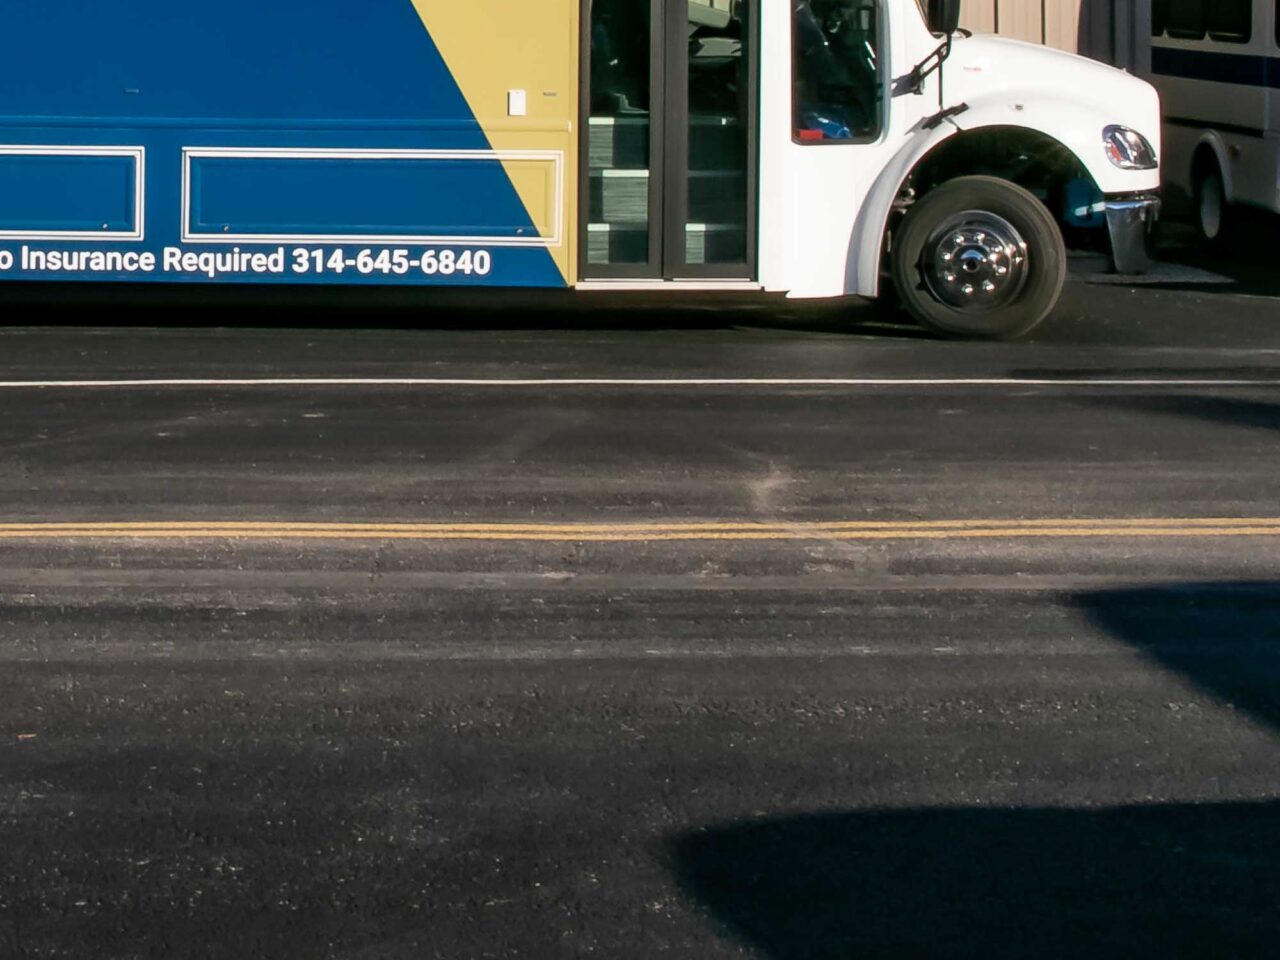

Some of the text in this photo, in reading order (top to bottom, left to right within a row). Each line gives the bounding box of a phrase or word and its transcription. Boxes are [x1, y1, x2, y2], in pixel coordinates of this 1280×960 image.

[21, 245, 156, 272] Insurance
[163, 246, 284, 278] Required
[291, 248, 491, 275] 314-645-6840
